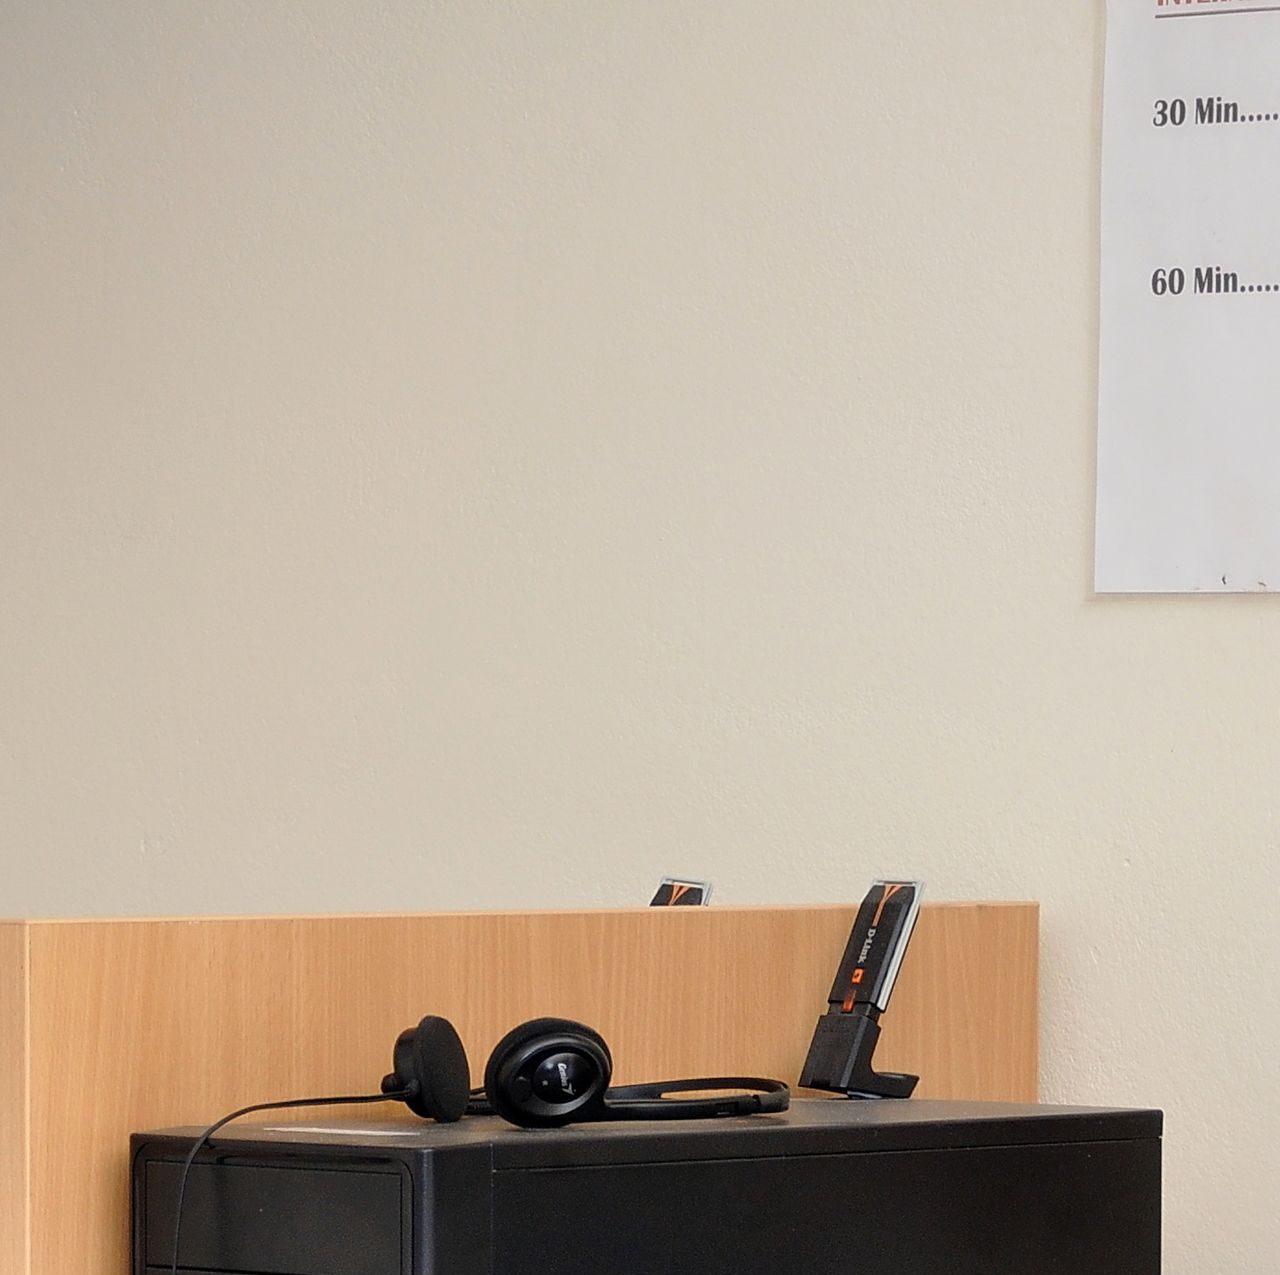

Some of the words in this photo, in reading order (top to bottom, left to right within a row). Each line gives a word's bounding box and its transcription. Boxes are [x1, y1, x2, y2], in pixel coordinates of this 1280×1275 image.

[1152, 99, 1186, 127] 30
[1151, 268, 1185, 296] 60
[857, 928, 877, 963] D-Link
